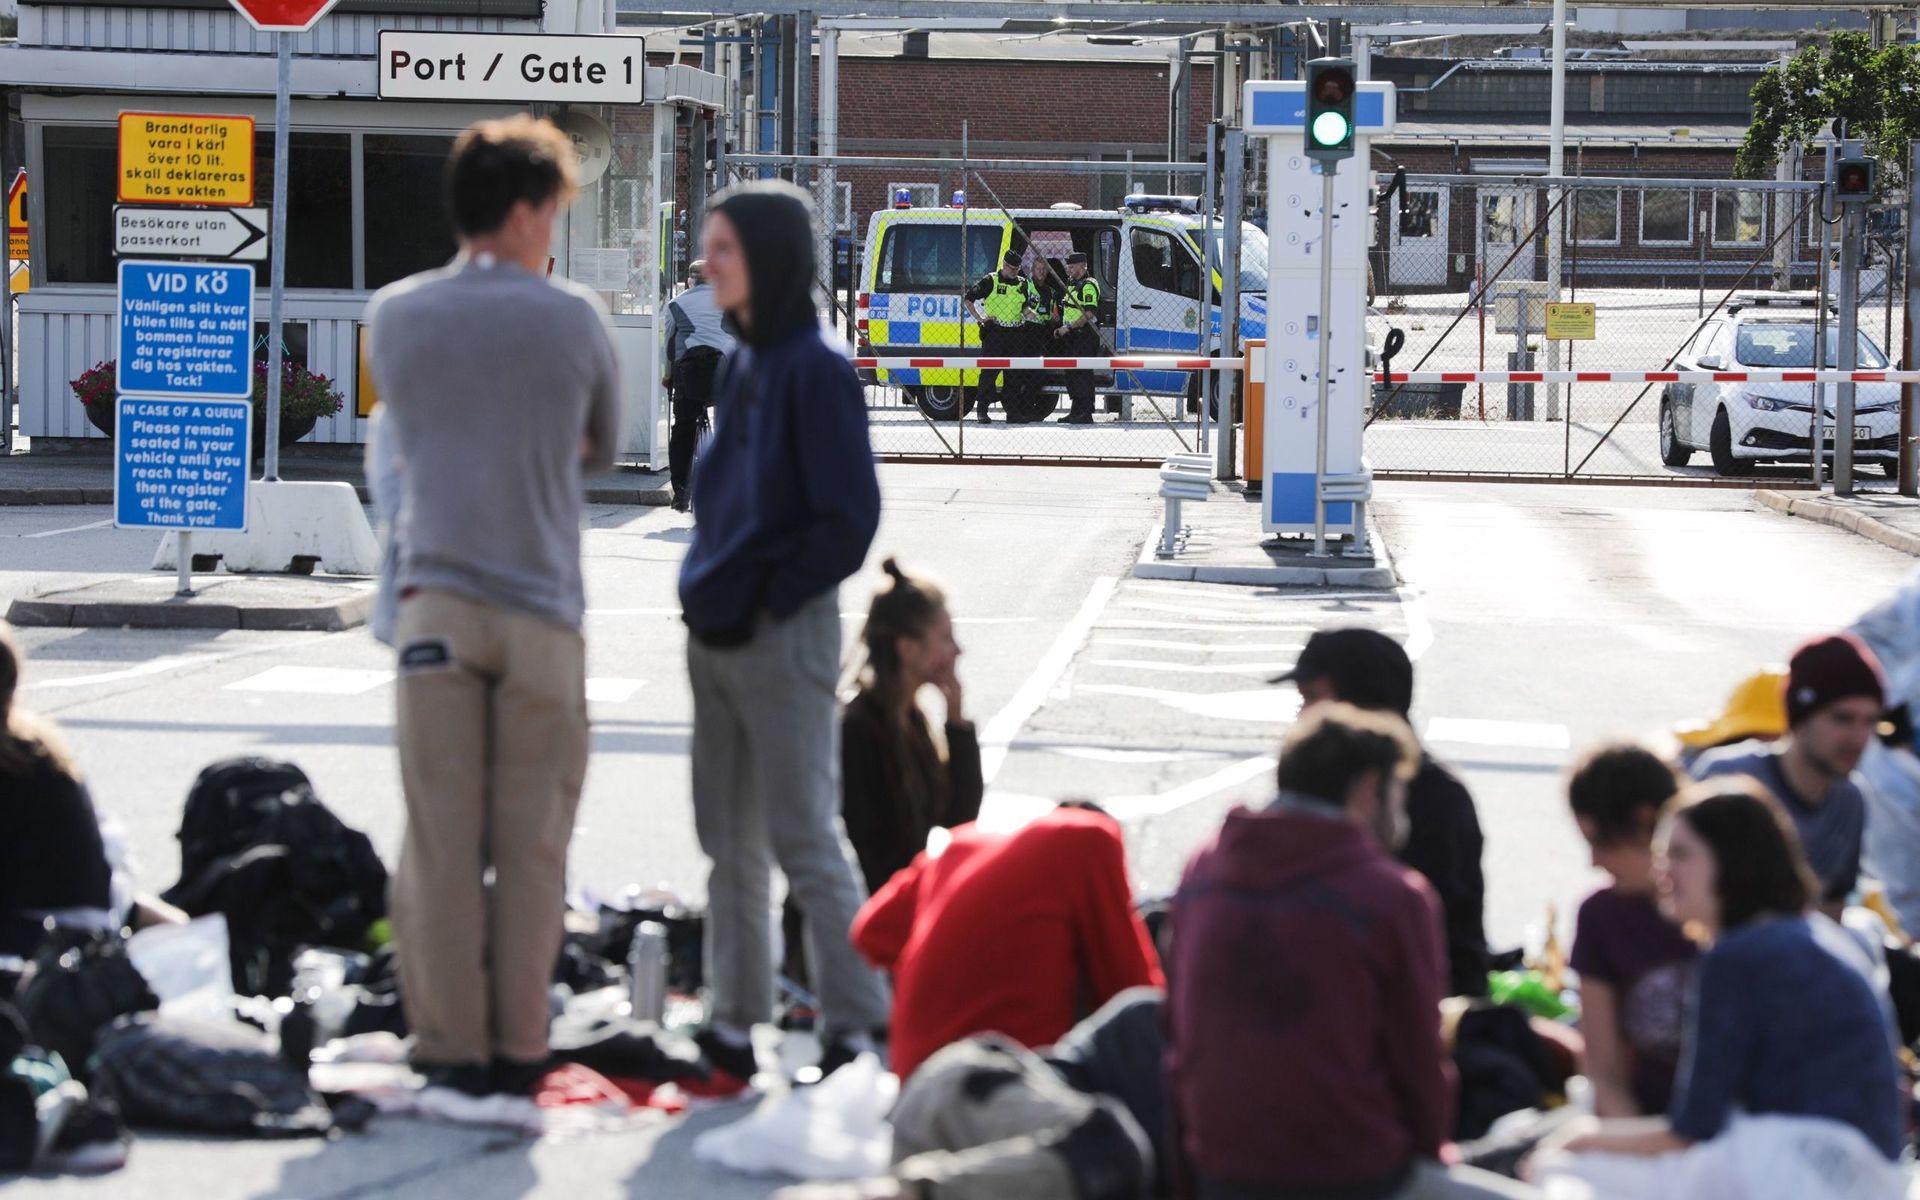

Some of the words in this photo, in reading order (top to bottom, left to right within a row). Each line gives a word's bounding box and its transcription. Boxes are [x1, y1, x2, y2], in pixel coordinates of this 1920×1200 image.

[391, 50, 466, 81] Port
[482, 53, 503, 81] /
[520, 53, 607, 83] Gate
[622, 56, 632, 84] 1
[145, 121, 228, 138] Brandfarlig
[149, 139, 181, 149] vara
[187, 138, 191, 149] i
[196, 138, 225, 150] kärl
[148, 152, 181, 165] över
[186, 154, 201, 165] 10
[206, 154, 224, 166] lit.
[126, 167, 160, 179] skall
[166, 169, 246, 182] deklareras
[145, 183, 171, 195] hos
[177, 184, 226, 197] vakten
[121, 215, 189, 230] Besökare
[195, 218, 227, 230] utan
[120, 235, 200, 247] passerkort
[147, 272, 188, 293] VID
[195, 270, 228, 294] KÖ
[125, 298, 185, 315] Vänligen
[189, 301, 211, 314] sitt
[213, 303, 246, 315] kvar
[133, 315, 167, 328] bilen
[170, 316, 195, 330] tills
[199, 318, 216, 330] du
[220, 318, 247, 331] nått
[135, 329, 193, 343] bommen
[197, 332, 234, 345] innan
[136, 344, 153, 356] du
[157, 345, 233, 360] registrerar
[131, 358, 153, 373] dig
[156, 359, 182, 372] hos
[186, 360, 237, 374] vakten.
[165, 373, 203, 386] Tack!
[122, 404, 135, 415] IN
[138, 405, 169, 416] CASE
[173, 406, 189, 417] OF
[191, 407, 201, 418] A
[204, 407, 245, 419] QUEUE
[132, 420, 181, 434] Please
[185, 422, 234, 437] remain
[131, 437, 180, 450] seated
[184, 438, 197, 450] in
[201, 440, 235, 453] your
[124, 451, 176, 464] vehicle
[180, 452, 211, 465] until
[214, 455, 241, 468] you
[132, 466, 172, 479] reach
[176, 467, 199, 480] the
[203, 468, 232, 483] bar,
[135, 480, 167, 494] then
[171, 482, 228, 497] register
[140, 496, 154, 508] at
[159, 496, 181, 509] the
[185, 498, 221, 512] gate.
[147, 511, 185, 524] Thank
[188, 514, 216, 526] you!
